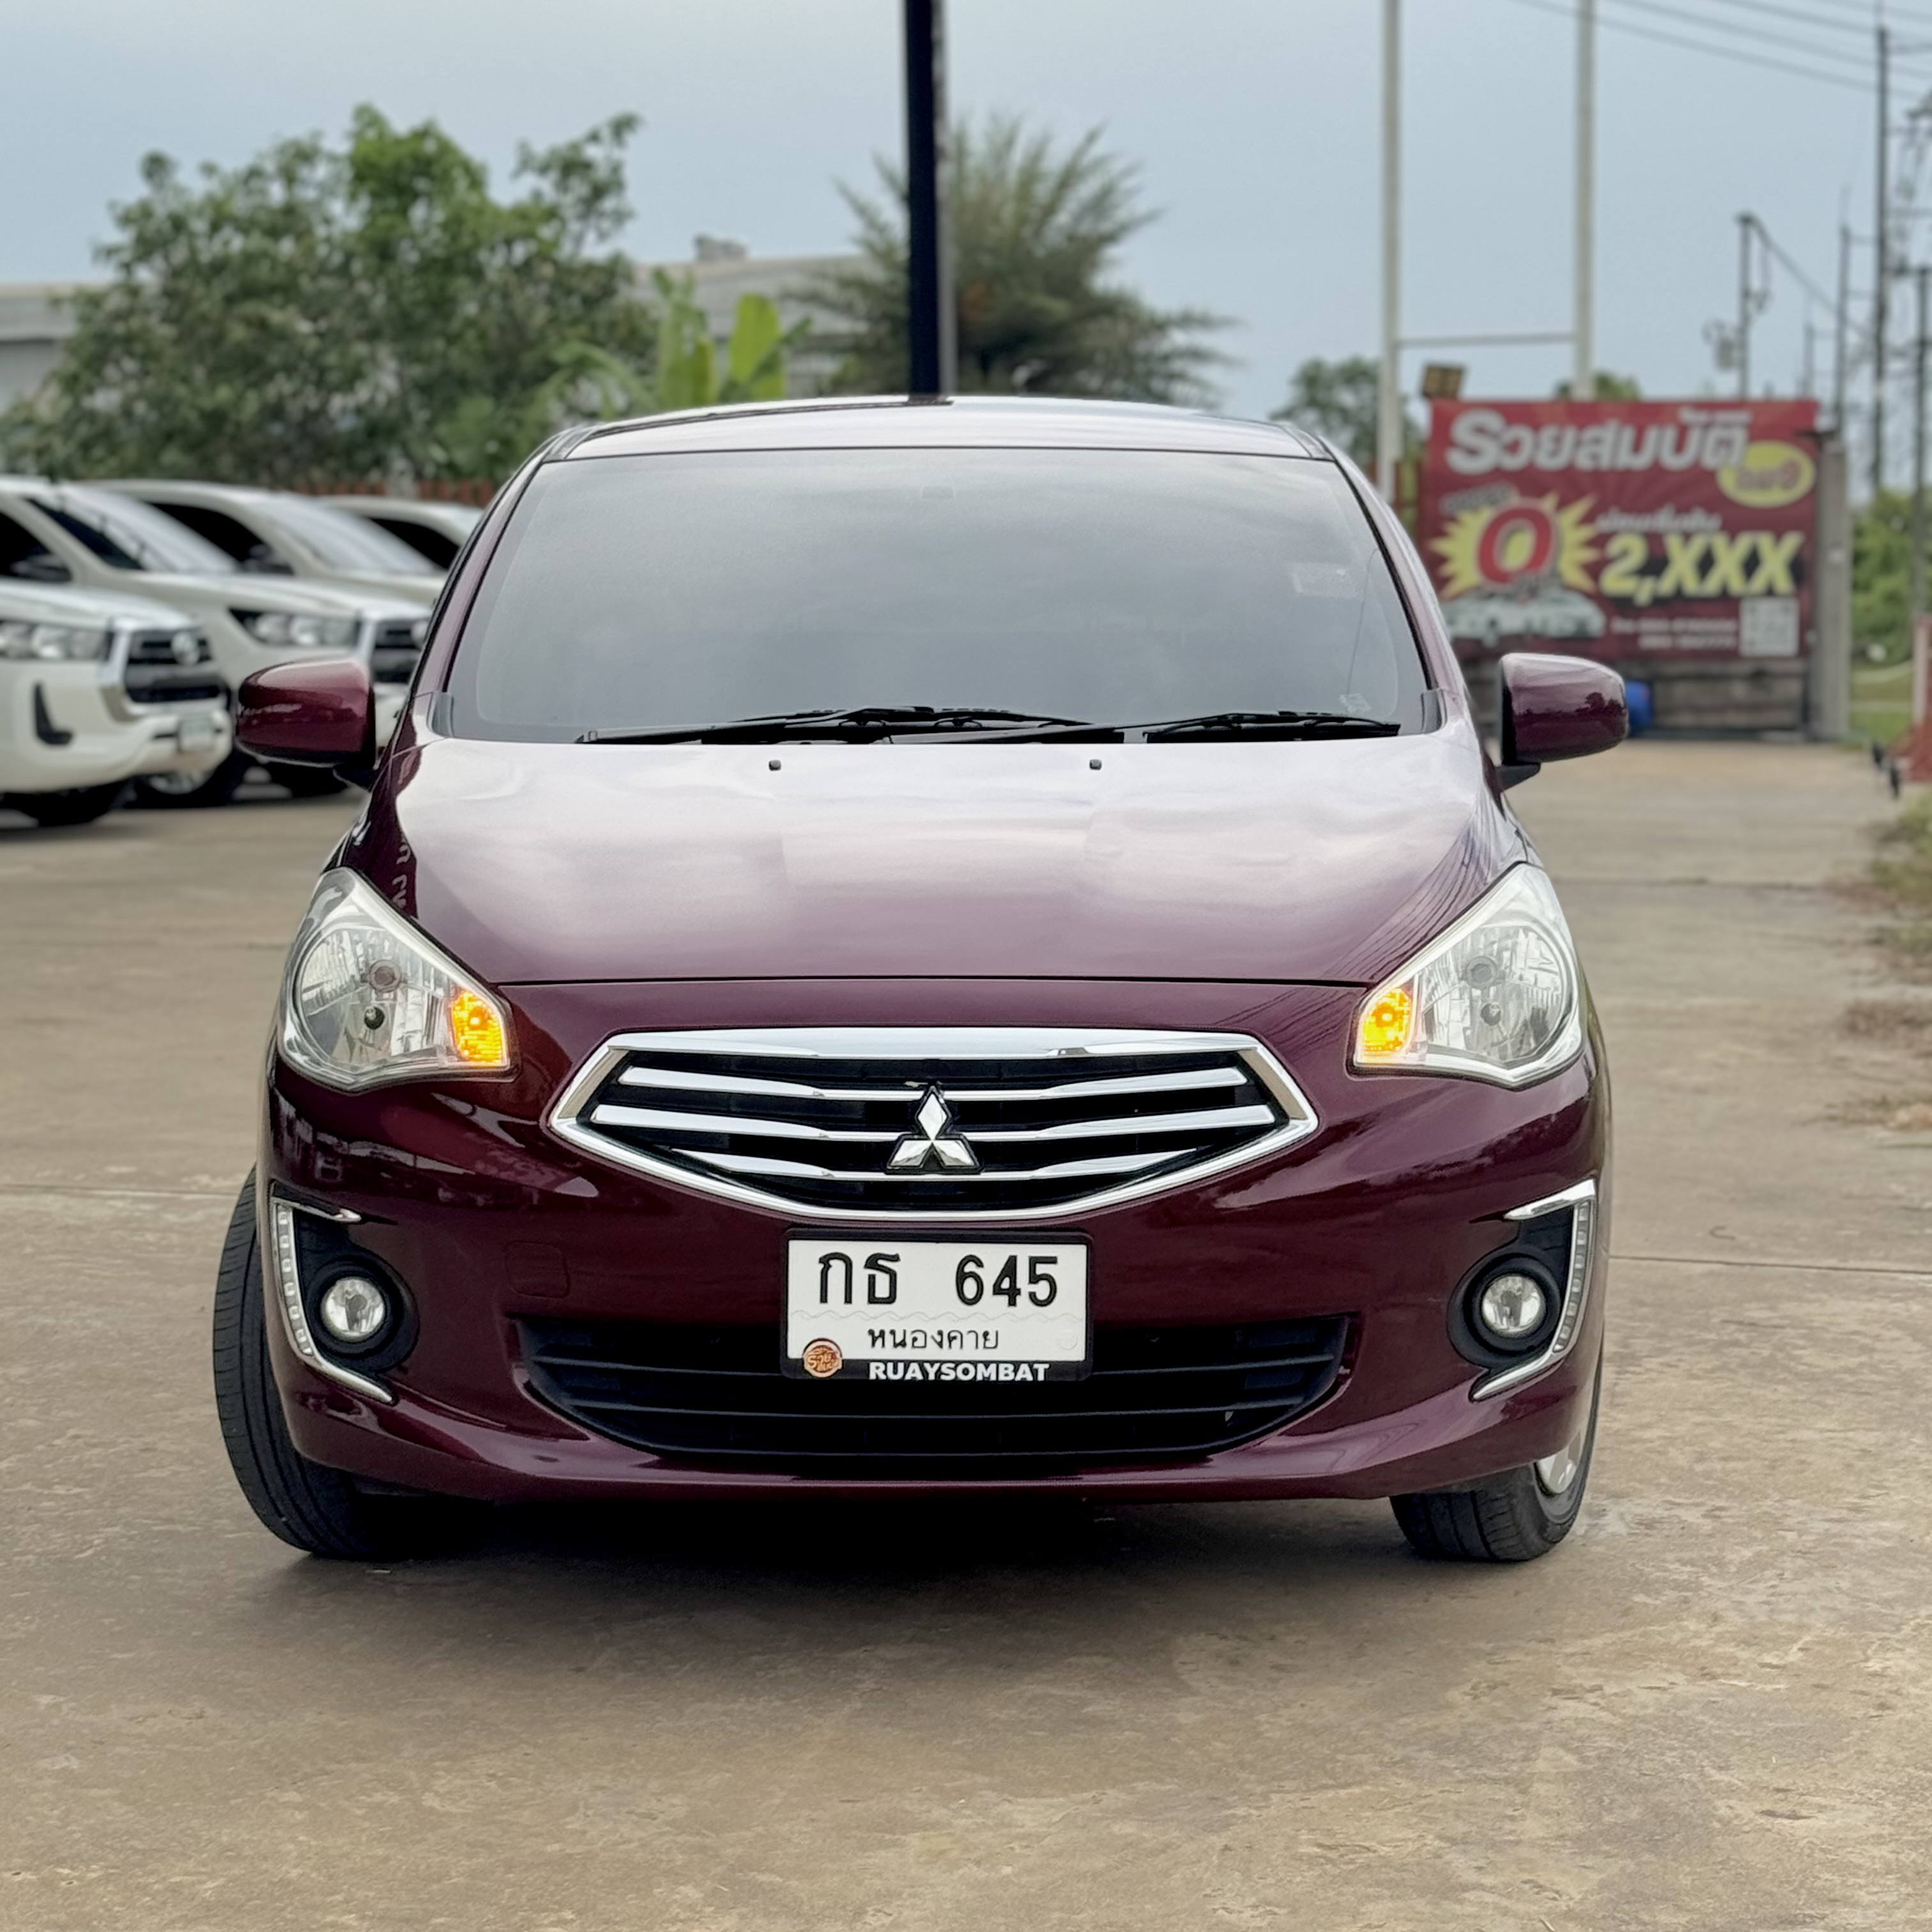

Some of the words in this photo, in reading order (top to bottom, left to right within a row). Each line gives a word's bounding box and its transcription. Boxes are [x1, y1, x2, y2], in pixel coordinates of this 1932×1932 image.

[1445, 406, 1753, 475] รวยสมบัติ
[1600, 532, 1804, 604] 2,XXX
[818, 1252, 901, 1305] กธ
[954, 1254, 1059, 1307] 645
[867, 1328, 999, 1350] หนองคาย
[868, 1361, 1050, 1382] RUAYSOMBAT
